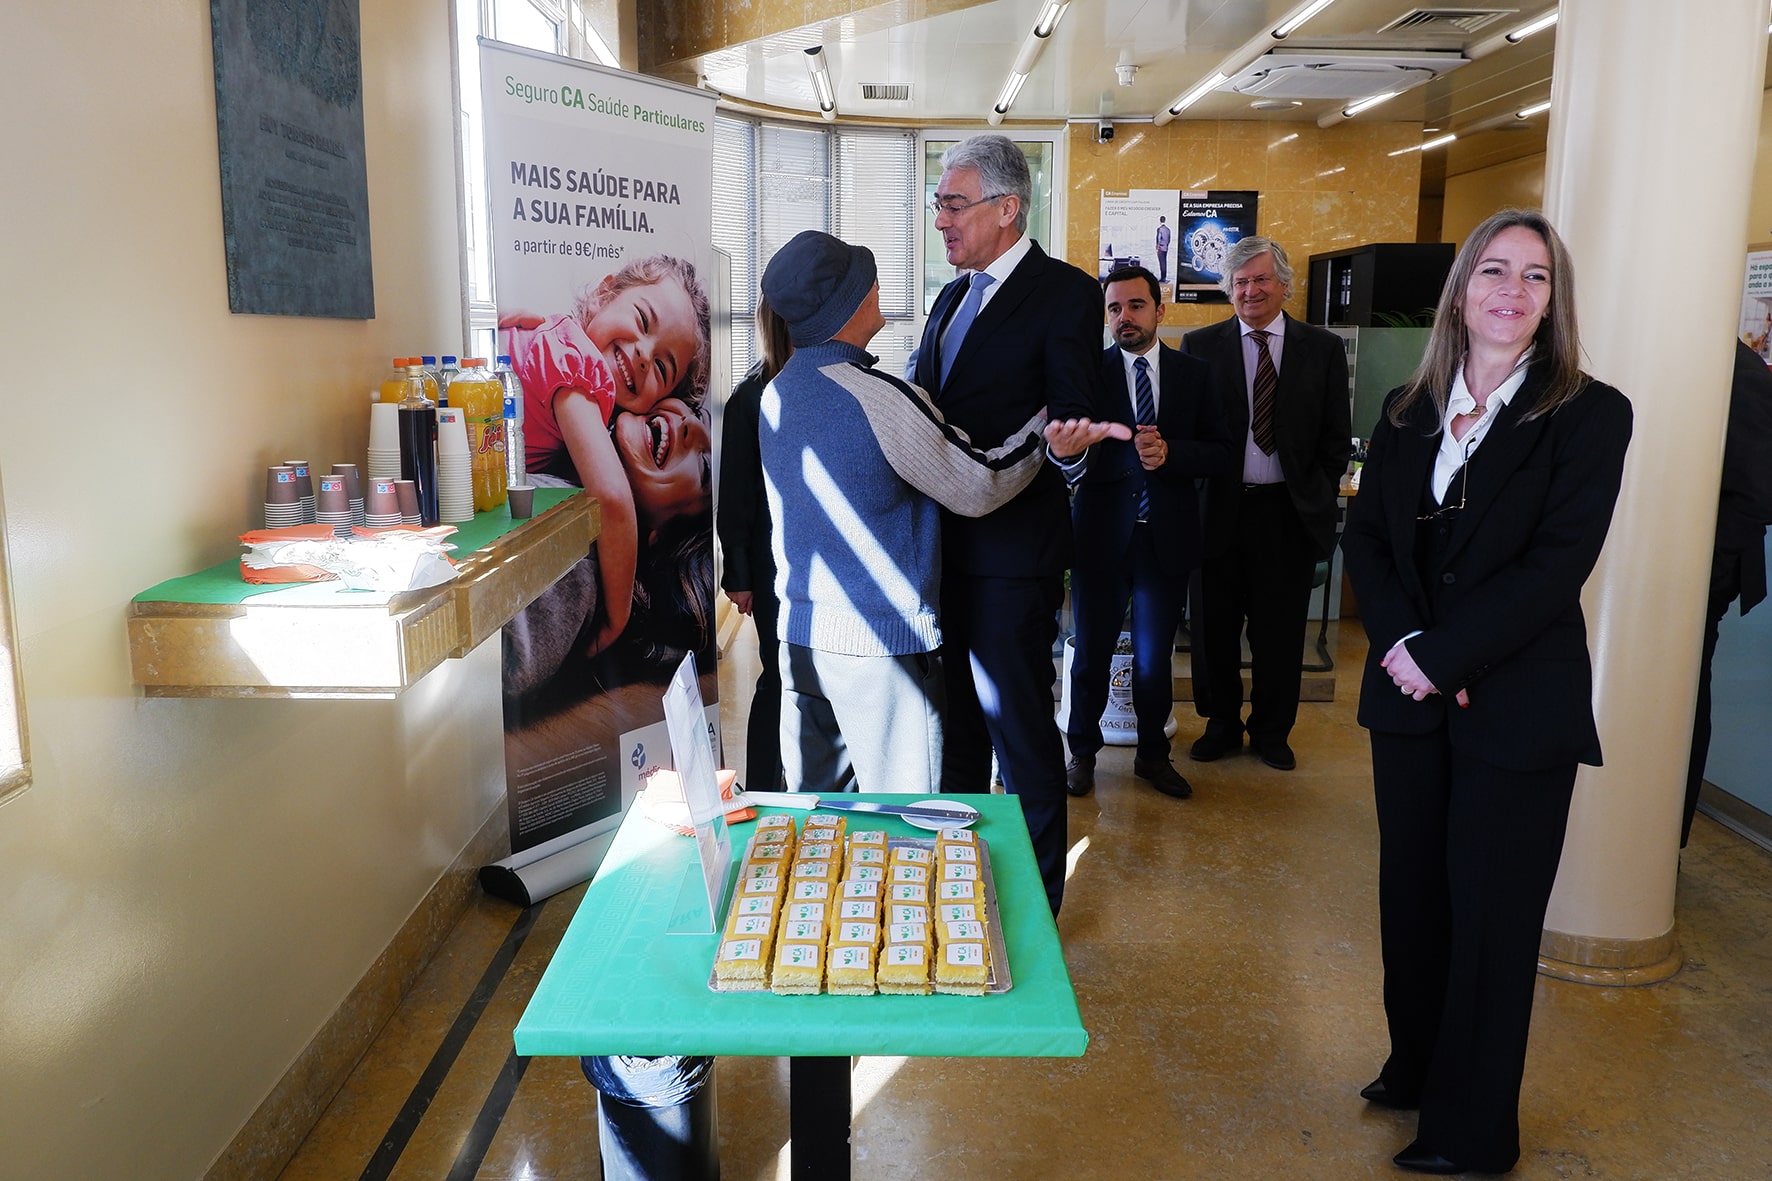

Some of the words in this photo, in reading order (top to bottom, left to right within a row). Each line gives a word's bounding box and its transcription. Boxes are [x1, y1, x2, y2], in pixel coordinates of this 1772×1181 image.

[505, 75, 558, 105] Seguro
[561, 85, 585, 110] CA
[588, 92, 629, 119] Saúde
[633, 104, 706, 134] Particulares
[510, 160, 562, 191] MAIS
[565, 167, 630, 199] SAÚDE
[633, 178, 681, 206] PARA
[512, 196, 527, 221] A
[530, 199, 571, 227] SUA
[575, 203, 655, 234] FAMÍLIA.
[1206, 210, 1218, 218] CA
[514, 240, 521, 251] a
[523, 238, 557, 256] partir
[559, 240, 572, 256] de
